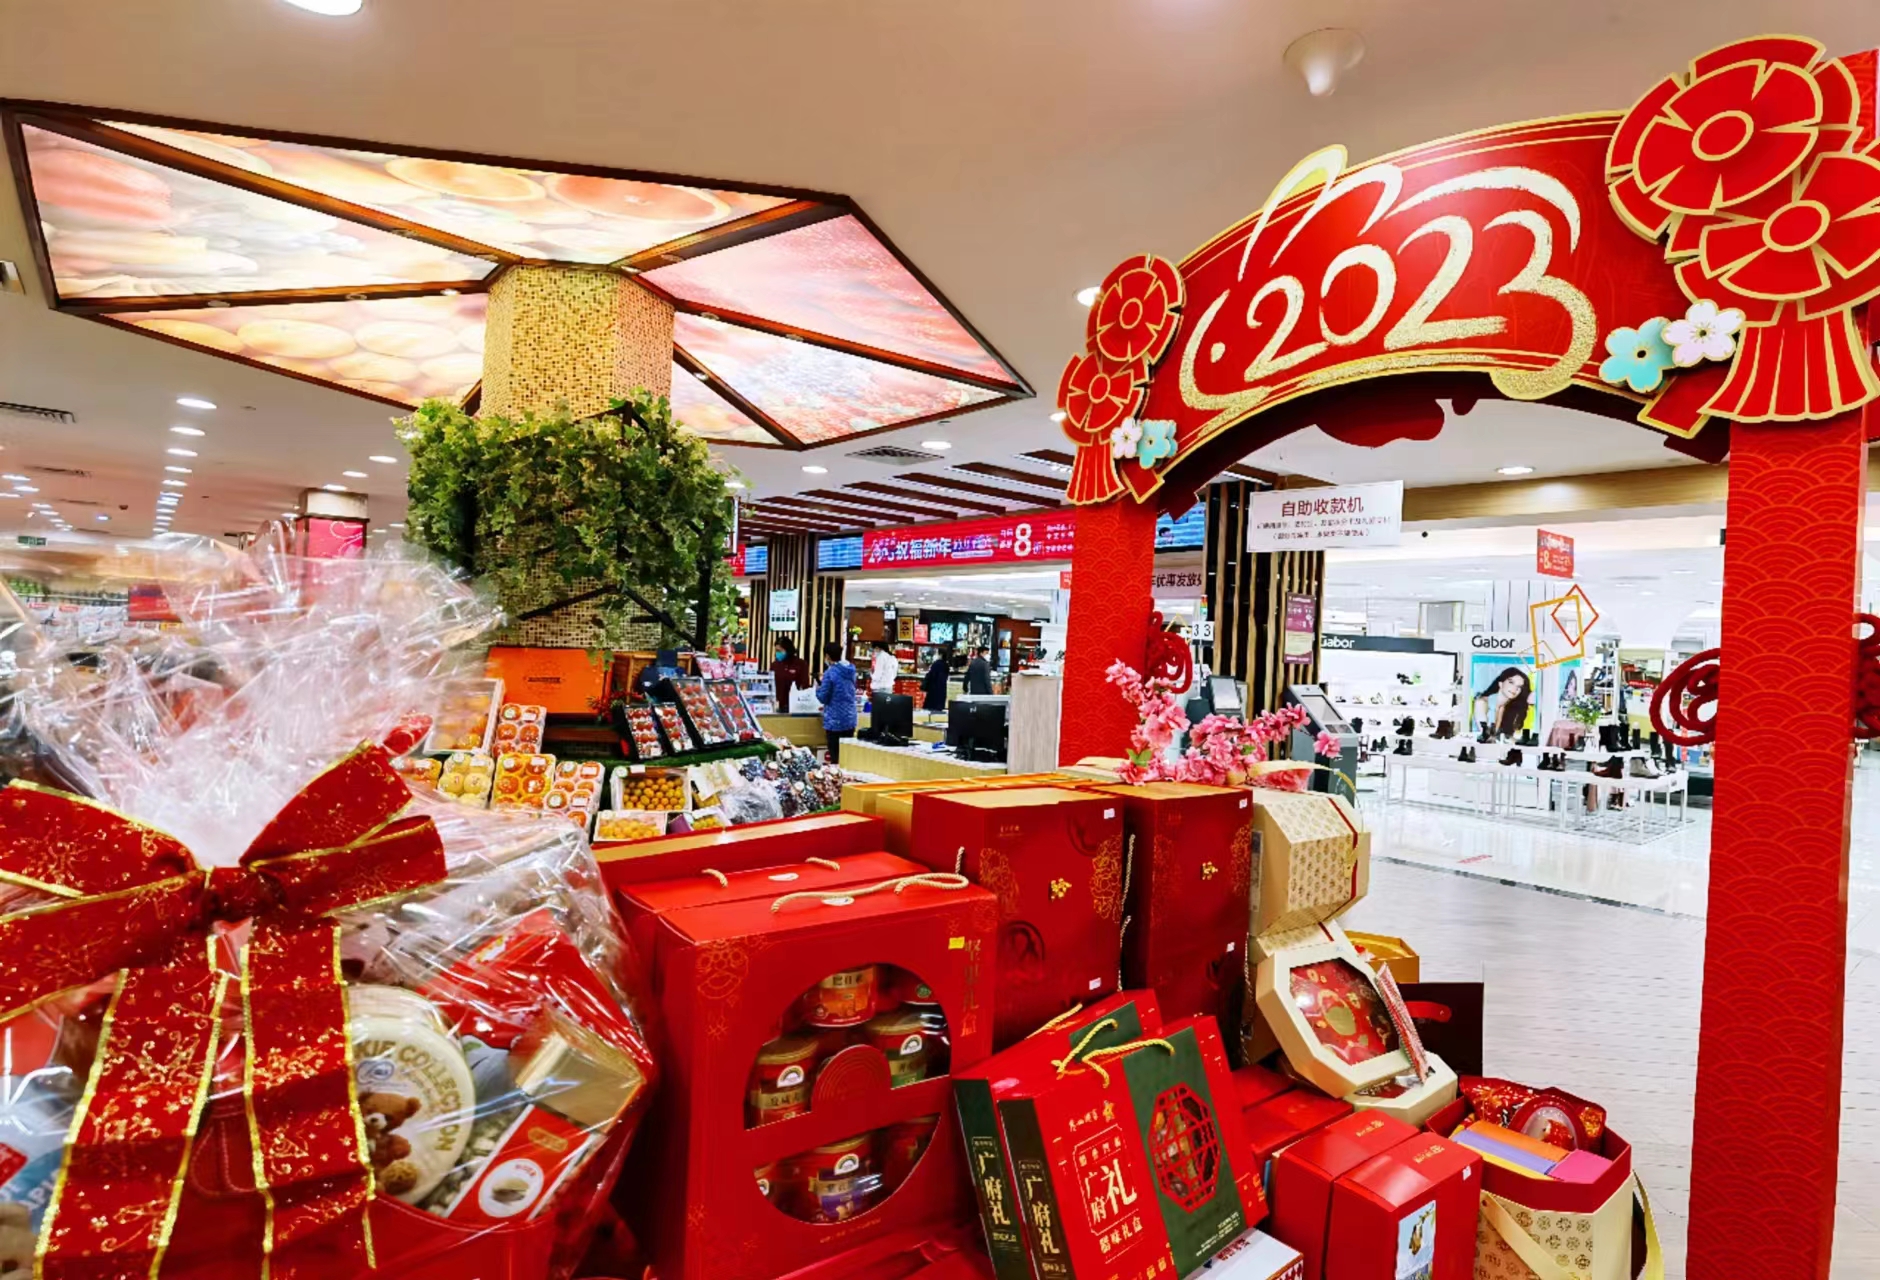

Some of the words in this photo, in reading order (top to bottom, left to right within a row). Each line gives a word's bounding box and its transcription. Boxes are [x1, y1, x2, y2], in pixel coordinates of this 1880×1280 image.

[1245, 208, 1598, 397] 2023
[1281, 496, 1364, 518] 自助收款机
[1471, 634, 1516, 649] Gabor
